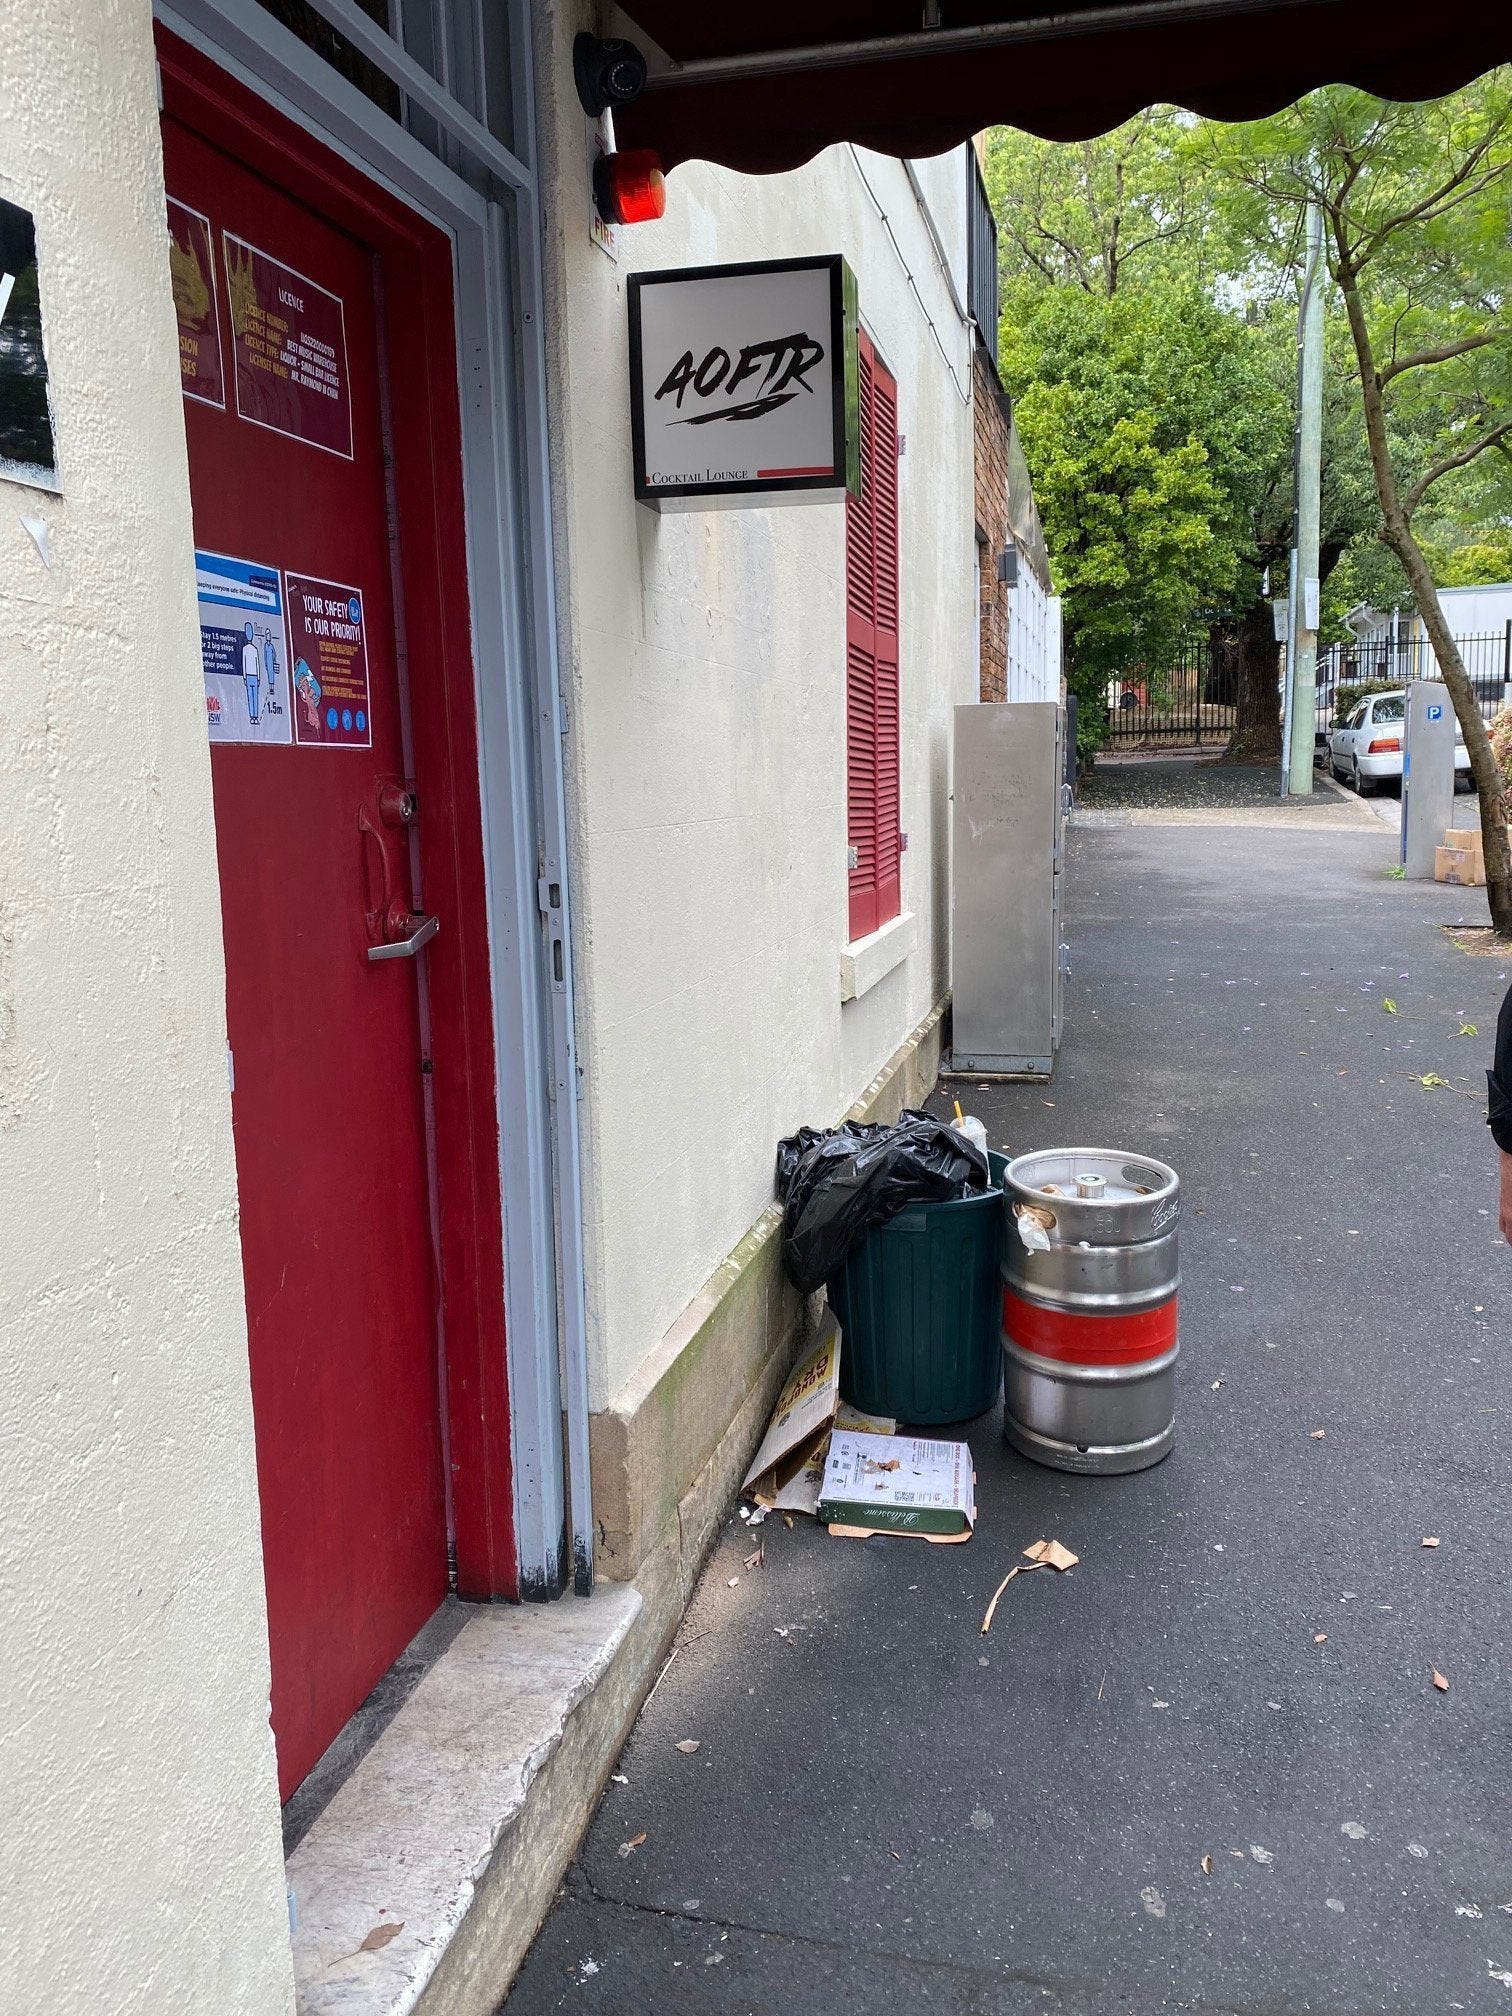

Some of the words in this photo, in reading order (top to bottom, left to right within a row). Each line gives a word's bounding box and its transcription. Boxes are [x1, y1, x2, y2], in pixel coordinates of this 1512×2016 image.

[595, 216, 615, 247] FIRE
[278, 287, 304, 313] LICENCE
[181, 357, 197, 377] SES
[652, 471, 704, 484] COCKTAIL
[706, 468, 749, 482] LOUNGE
[302, 594, 324, 614] YOUR
[324, 599, 348, 619] SAFETY
[304, 616, 313, 634] IS
[313, 619, 330, 637] OUR
[330, 621, 362, 645] PRIORITY!
[207, 641, 211, 649] 2
[211, 641, 220, 651] big
[220, 643, 234, 652] steps
[214, 651, 228, 660] from
[267, 700, 283, 715] 1.5m
[1429, 706, 1440, 719] P
